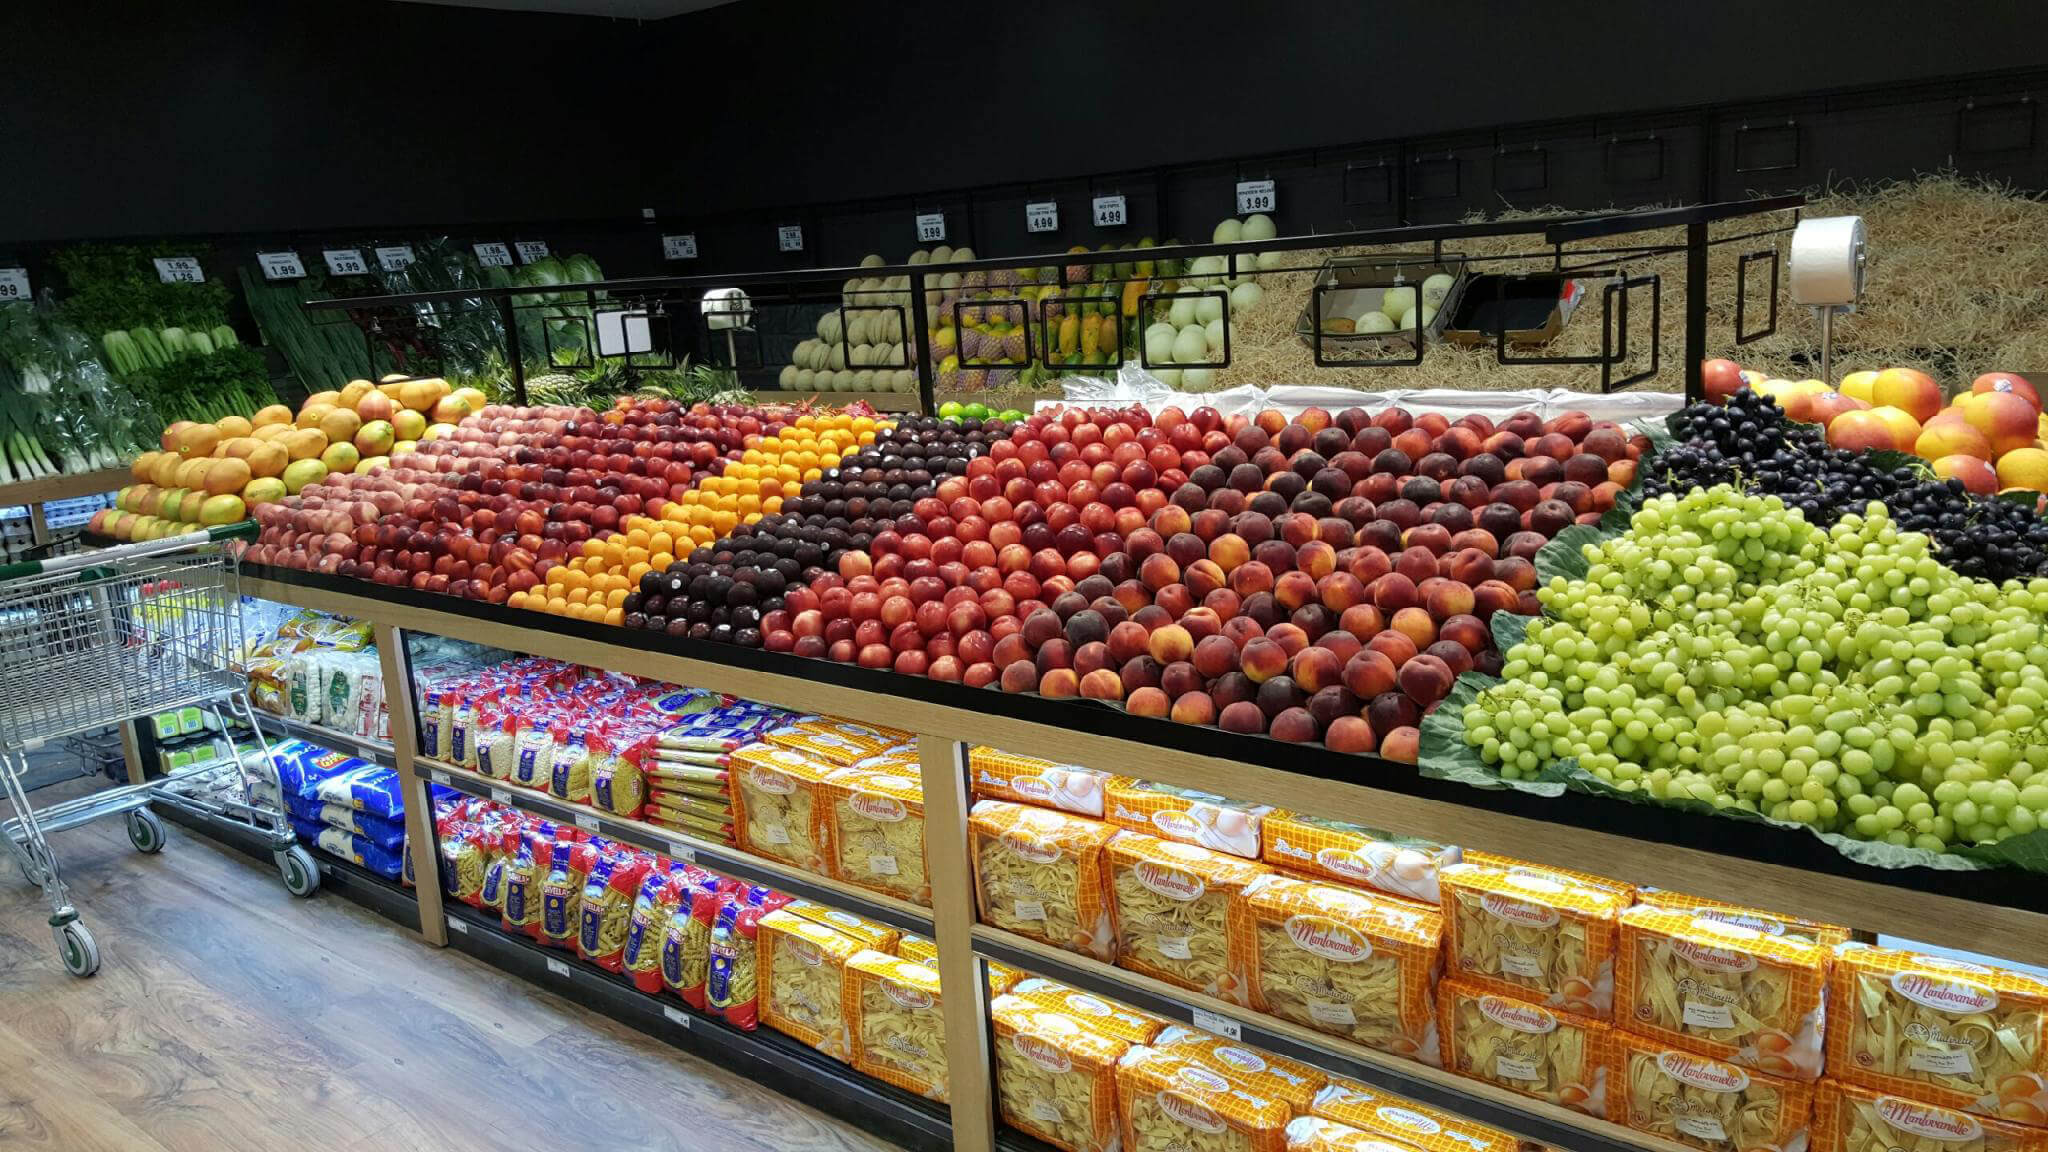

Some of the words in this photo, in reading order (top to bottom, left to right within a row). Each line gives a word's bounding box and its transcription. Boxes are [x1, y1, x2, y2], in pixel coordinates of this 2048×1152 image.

[272, 266, 296, 275] 1.99
[1294, 920, 1362, 956] Mantovanelle
[1907, 974, 1988, 1008] Mantovanelle
[1670, 1054, 1738, 1087] Mantovanelle
[1888, 1100, 1969, 1136] Mantovanelle
